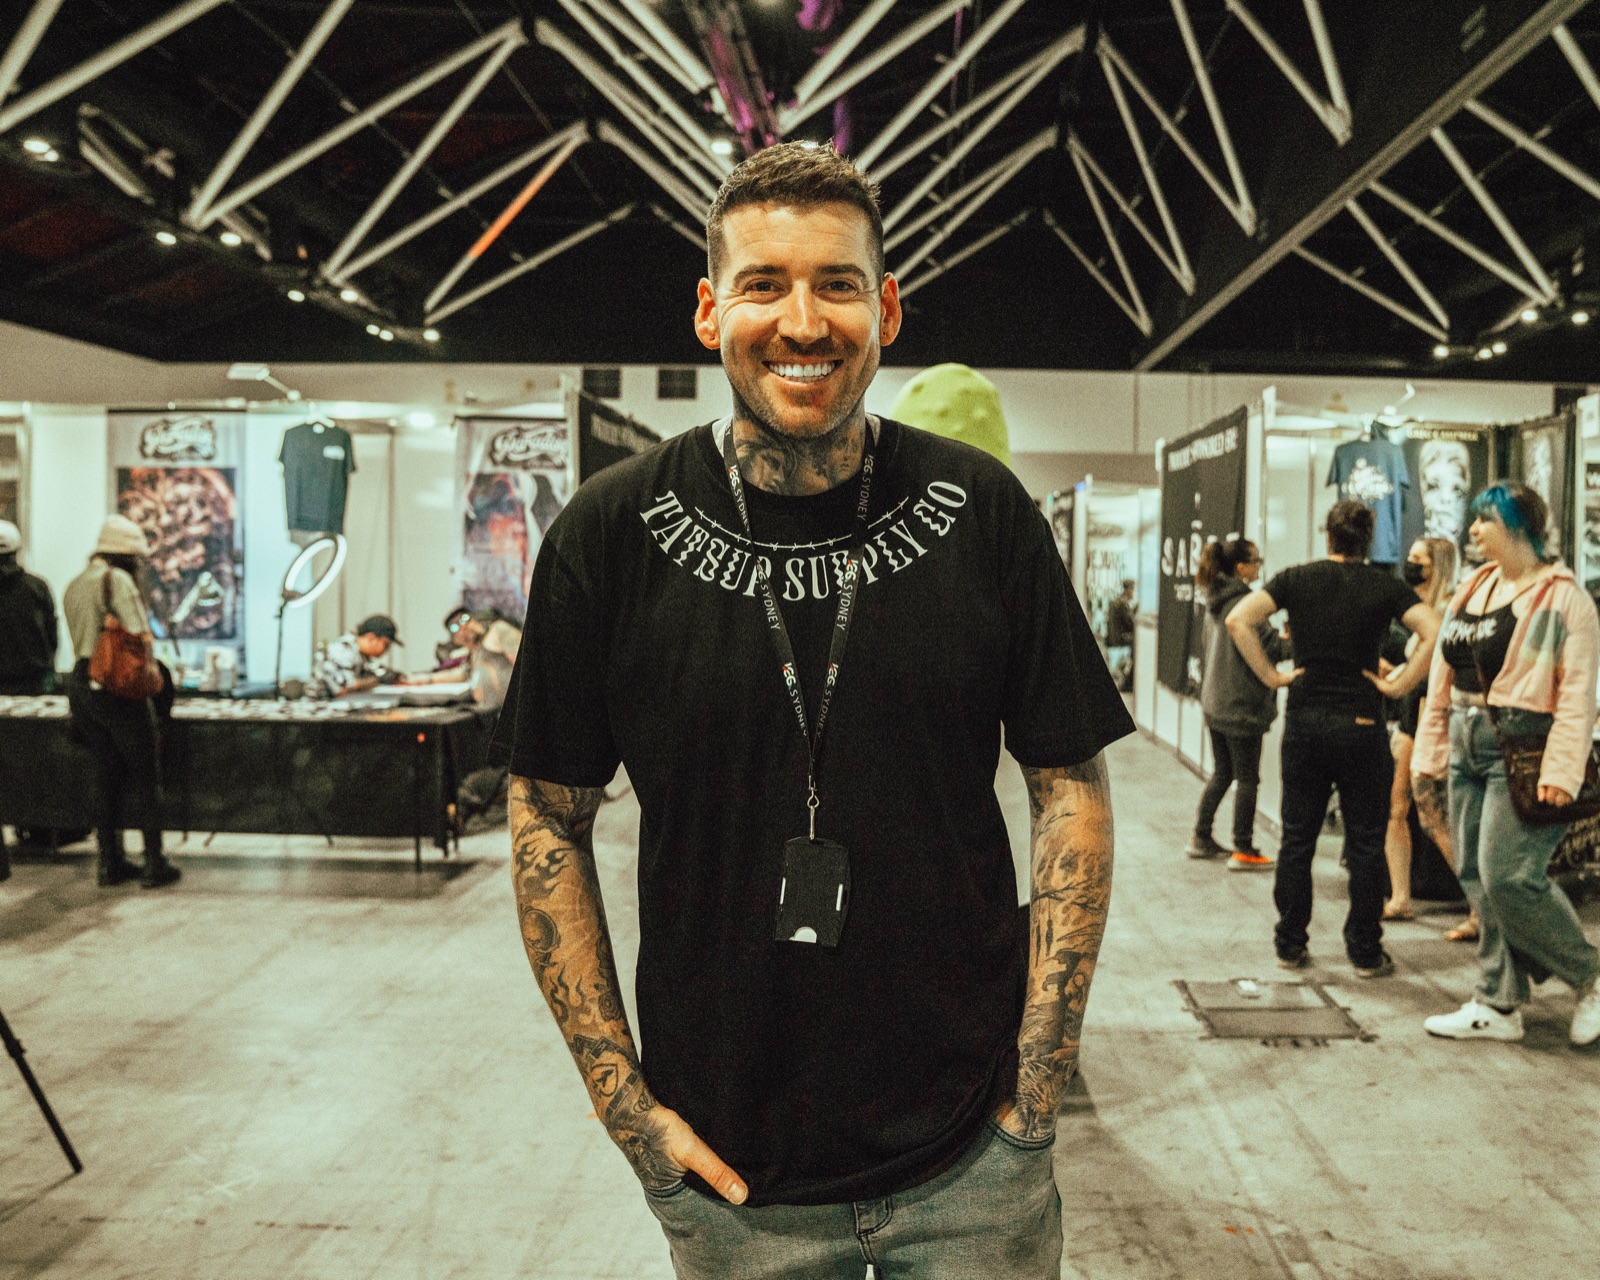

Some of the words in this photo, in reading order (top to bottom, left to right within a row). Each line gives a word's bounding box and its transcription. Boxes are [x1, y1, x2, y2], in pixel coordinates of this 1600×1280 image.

[857, 477, 871, 521] SYDNEY
[760, 584, 781, 631] SYDNEY
[836, 583, 854, 631] SYDNEY
